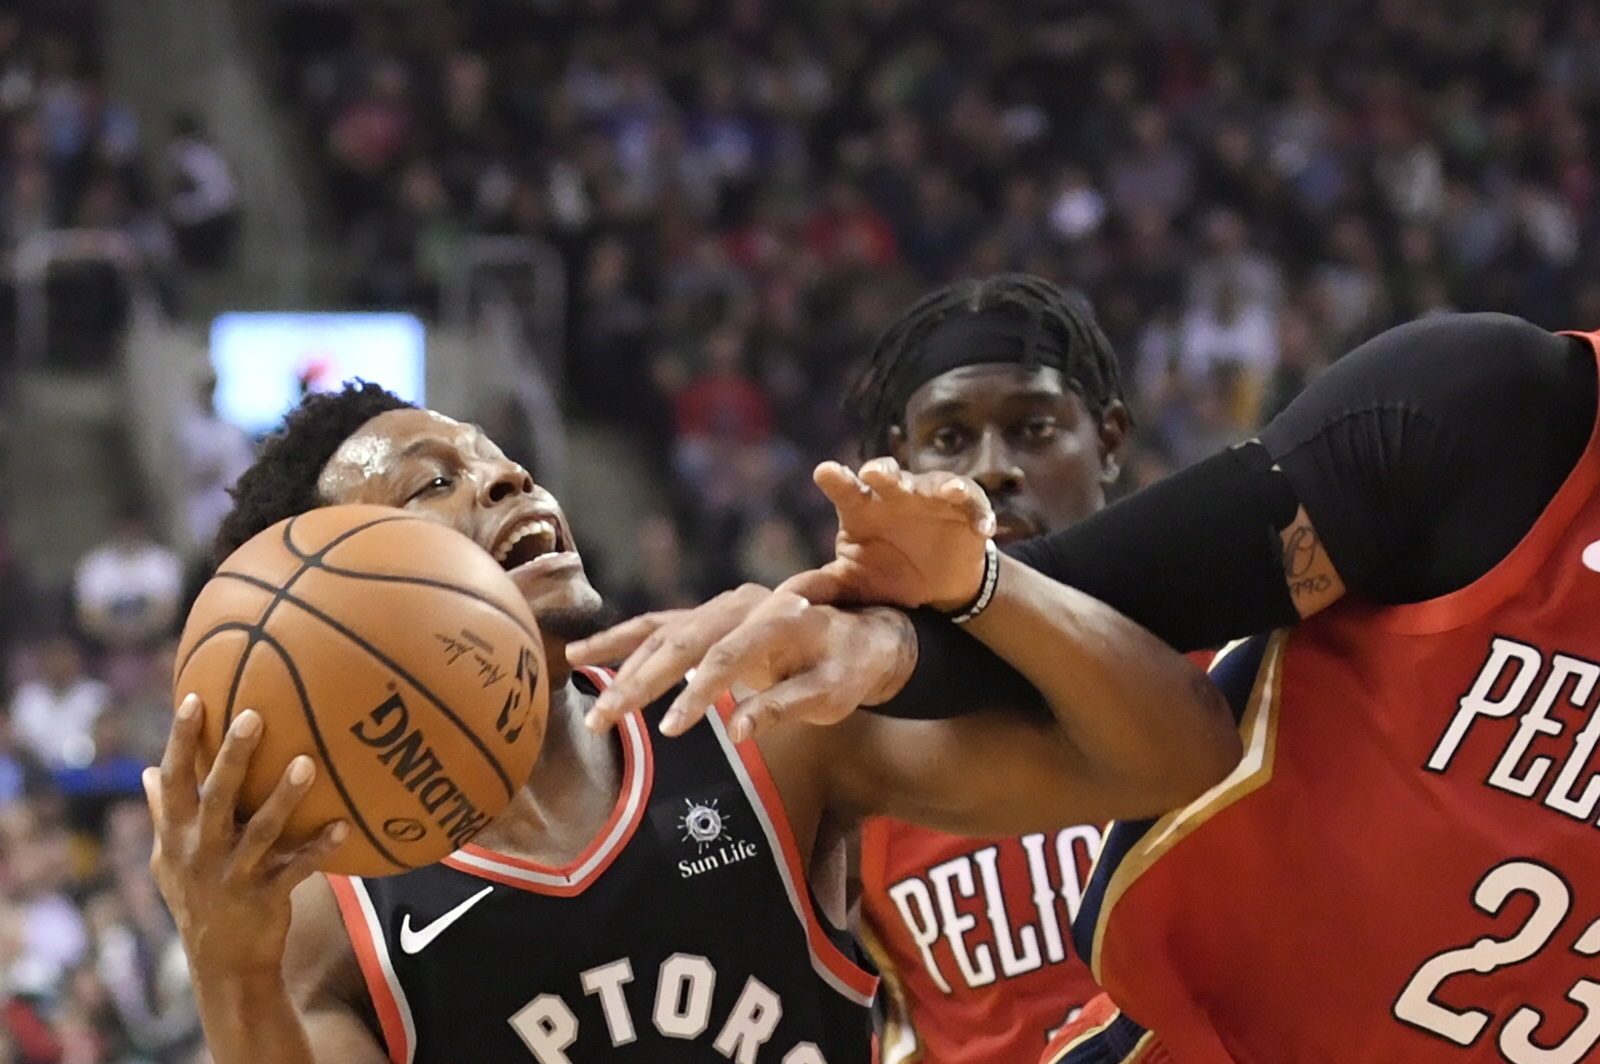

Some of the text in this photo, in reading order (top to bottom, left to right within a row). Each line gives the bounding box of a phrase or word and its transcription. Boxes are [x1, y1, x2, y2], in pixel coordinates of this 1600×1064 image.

[350, 691, 494, 852] PALDING
[678, 839, 758, 879] Sun Life
